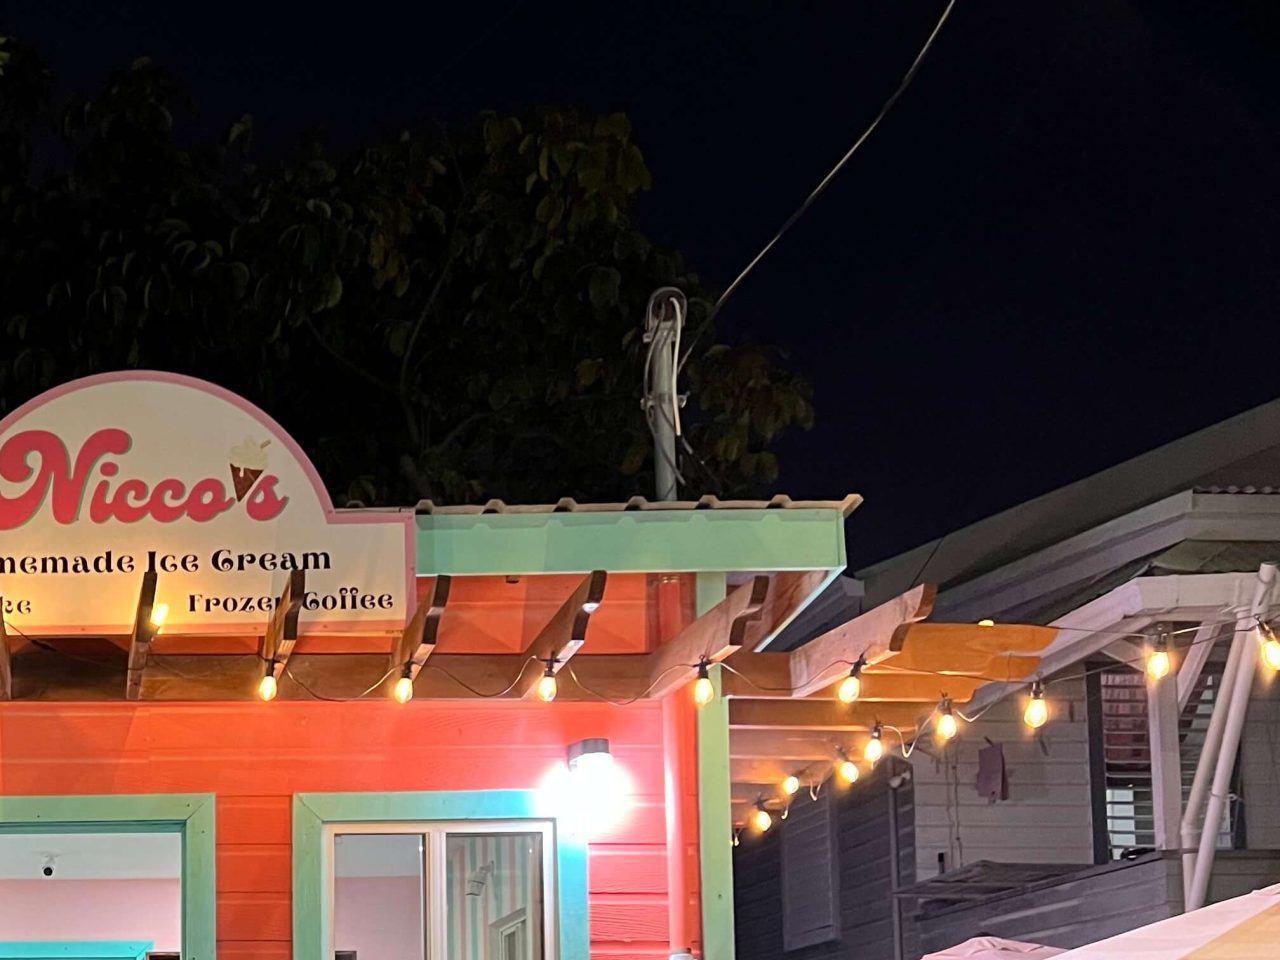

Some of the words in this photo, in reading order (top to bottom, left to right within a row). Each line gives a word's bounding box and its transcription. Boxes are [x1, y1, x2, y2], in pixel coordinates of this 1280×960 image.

[146, 551, 200, 574] Ice
[211, 548, 333, 573] Cream
[188, 593, 280, 613] Froze
[302, 587, 394, 611] Coffee
